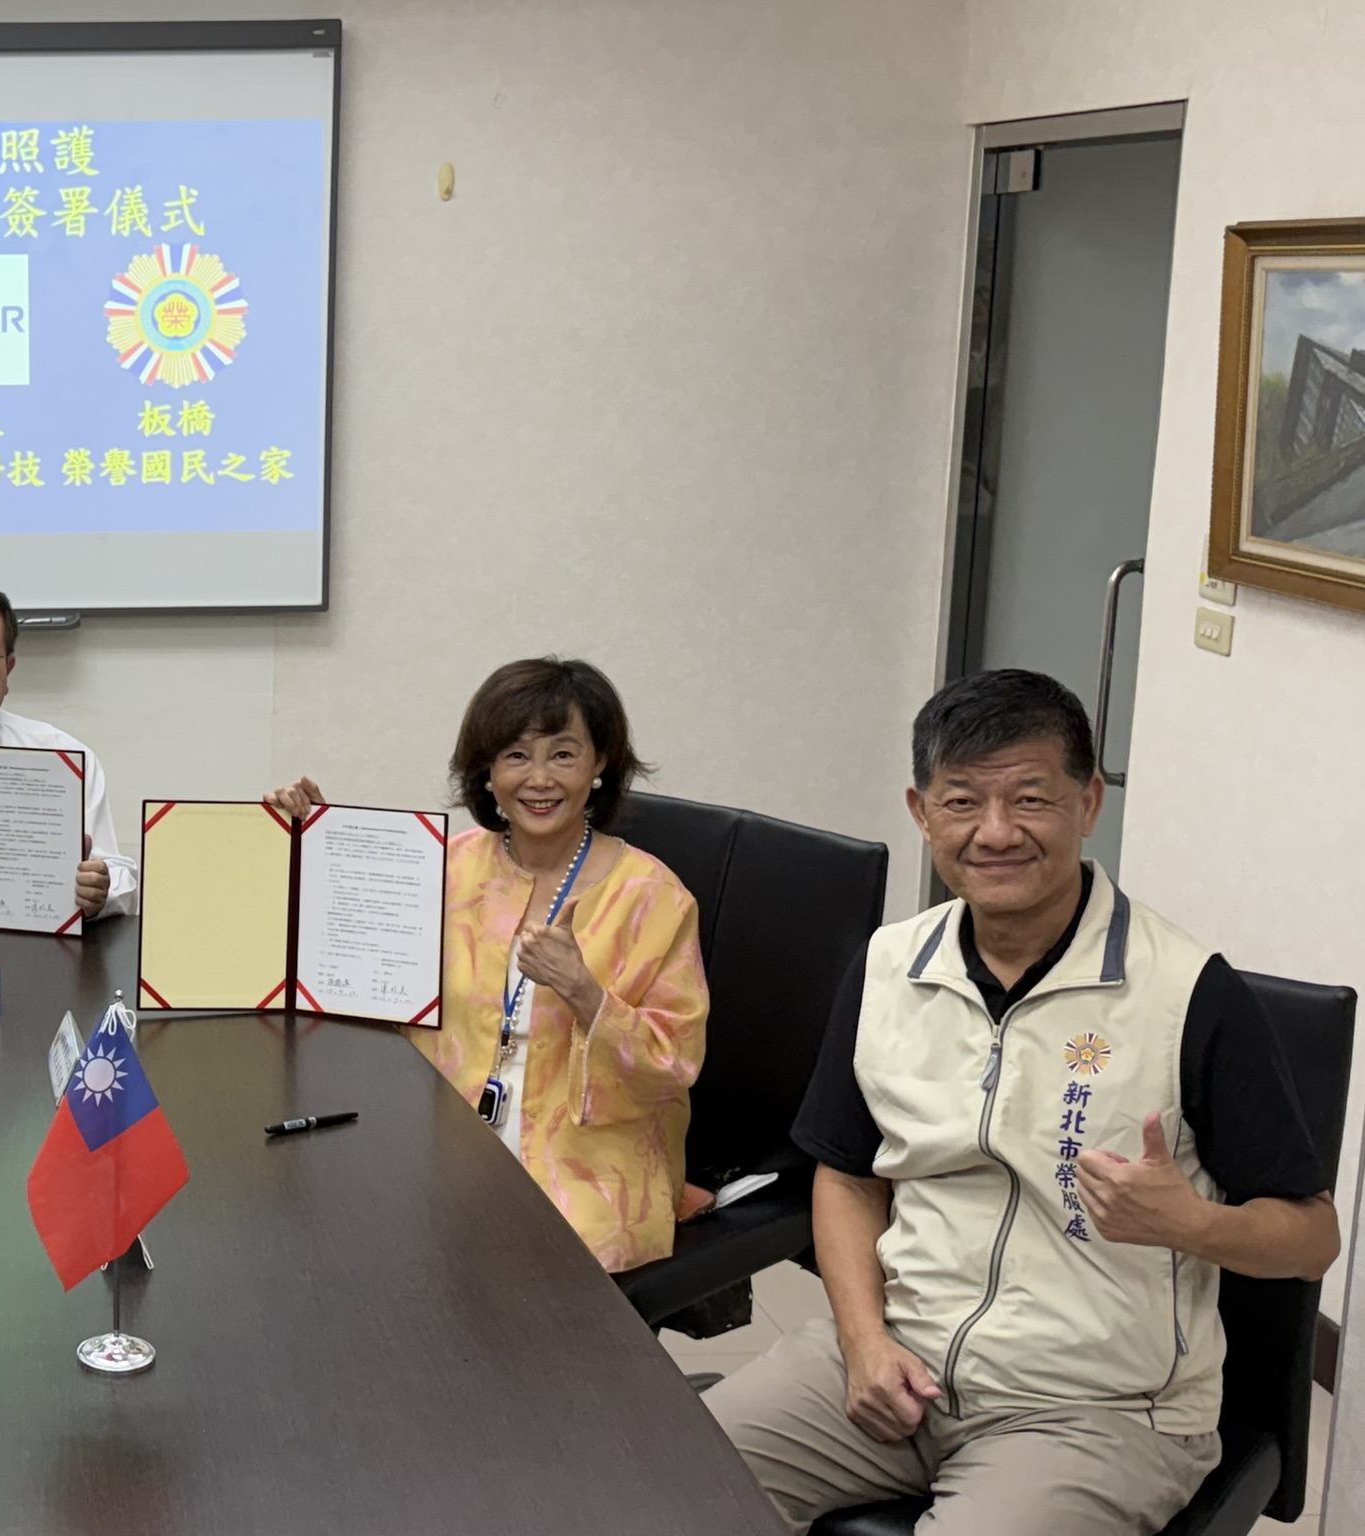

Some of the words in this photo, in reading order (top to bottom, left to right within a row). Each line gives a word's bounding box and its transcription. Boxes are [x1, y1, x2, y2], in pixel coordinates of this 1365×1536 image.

[137, 400, 216, 437] 板橋
[61, 446, 295, 487] 榮譽國民之家
[1055, 1080, 1092, 1242] 新北市榮服處
